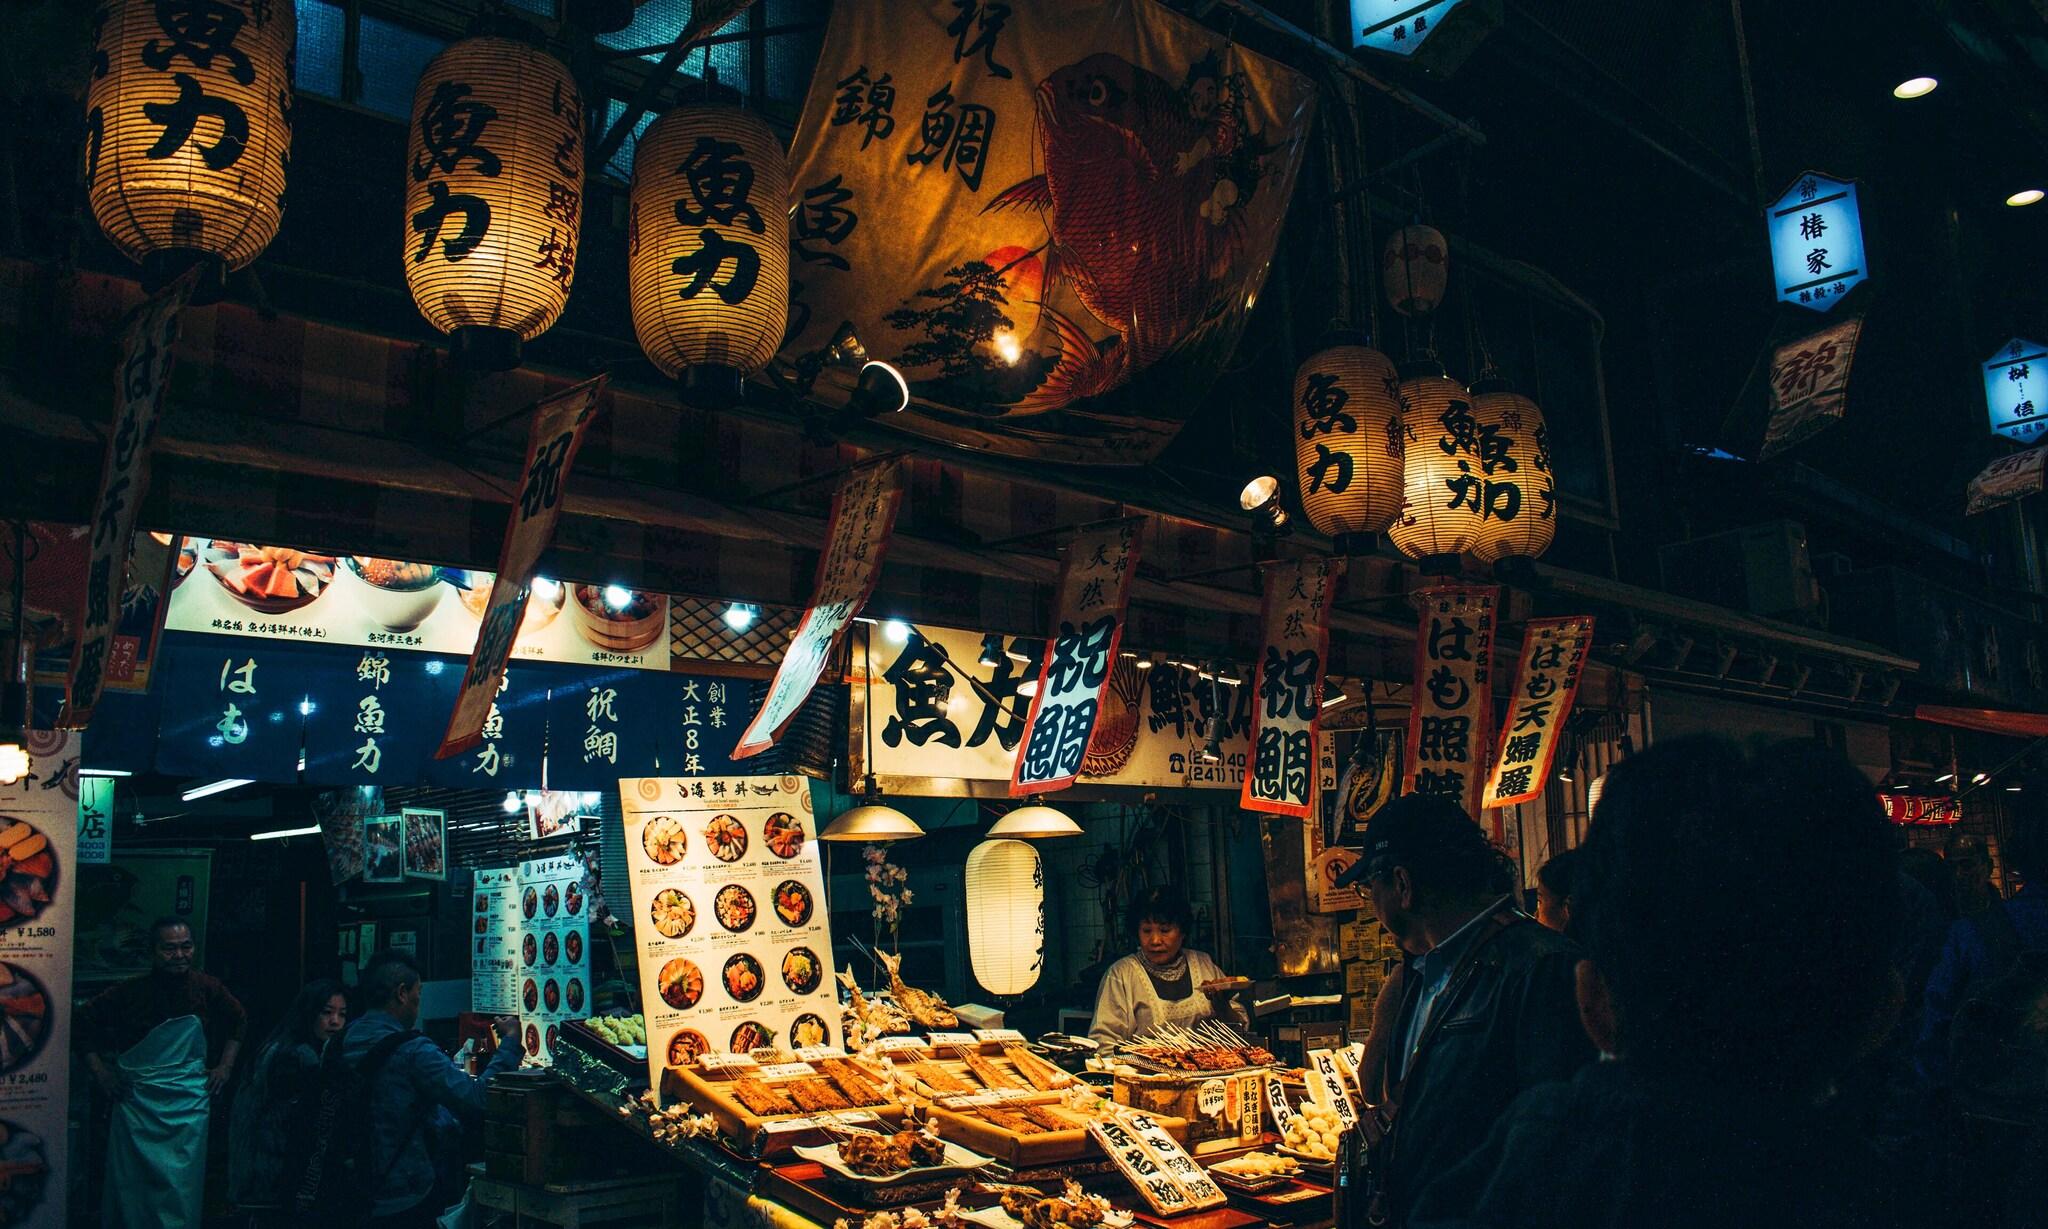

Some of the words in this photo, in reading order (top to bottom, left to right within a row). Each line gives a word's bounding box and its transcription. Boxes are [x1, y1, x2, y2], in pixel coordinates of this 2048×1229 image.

[412, 79, 502, 263] 魚力
[672, 136, 766, 305] 魚力
[1799, 212, 1833, 275] 椿家
[1300, 373, 1358, 495] 魚力
[216, 658, 258, 745] はも
[592, 651, 645, 665] 海鮮ひつまぶし
[881, 632, 1034, 752] 魚力
[1019, 615, 1117, 783] 祝鯛
[351, 654, 391, 774] 錦魚力
[584, 686, 619, 765] 祝鯛
[682, 678, 706, 777] 大正8年
[707, 682, 728, 729] 創業
[1250, 646, 1320, 806] 祝鯛
[1496, 643, 1565, 798] はも天婦羅
[78, 809, 105, 839] 店
[691, 780, 749, 799] 海鮮丼
[17, 926, 56, 938] ¥1,580
[9, 1073, 48, 1085] ¥2,480
[1129, 1114, 1216, 1199] はも照焼
